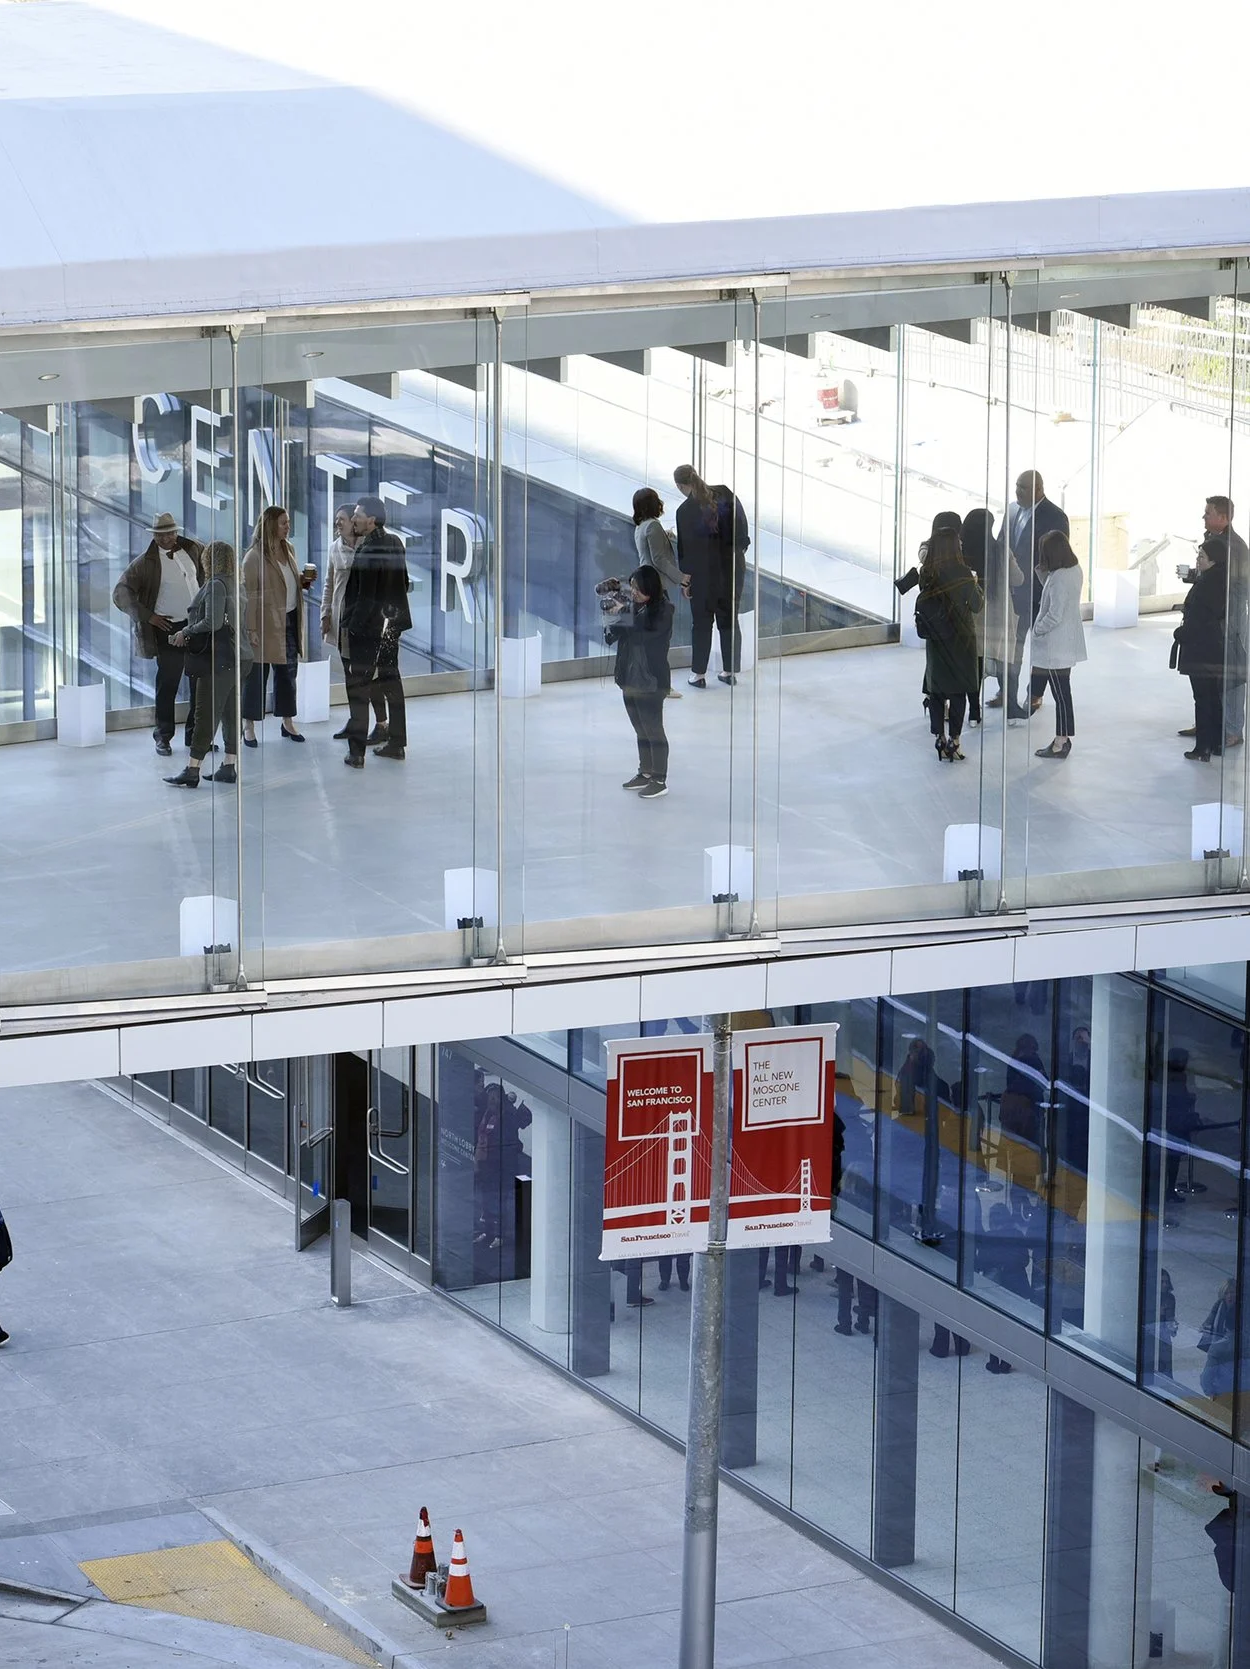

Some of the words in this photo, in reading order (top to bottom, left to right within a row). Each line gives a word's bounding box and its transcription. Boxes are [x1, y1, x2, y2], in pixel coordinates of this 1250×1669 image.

[752, 1060, 771, 1071] THE
[752, 1073, 769, 1083] ALL
[771, 1070, 794, 1081] NEW
[626, 1086, 669, 1097] WELCOME
[670, 1085, 682, 1094] TO
[752, 1082, 800, 1095] MOSCONE
[626, 1099, 644, 1108] SAN
[645, 1095, 693, 1106] FRANCISCO
[752, 1095, 787, 1108] CENTER
[459, 1137, 475, 1154] LOBBY
